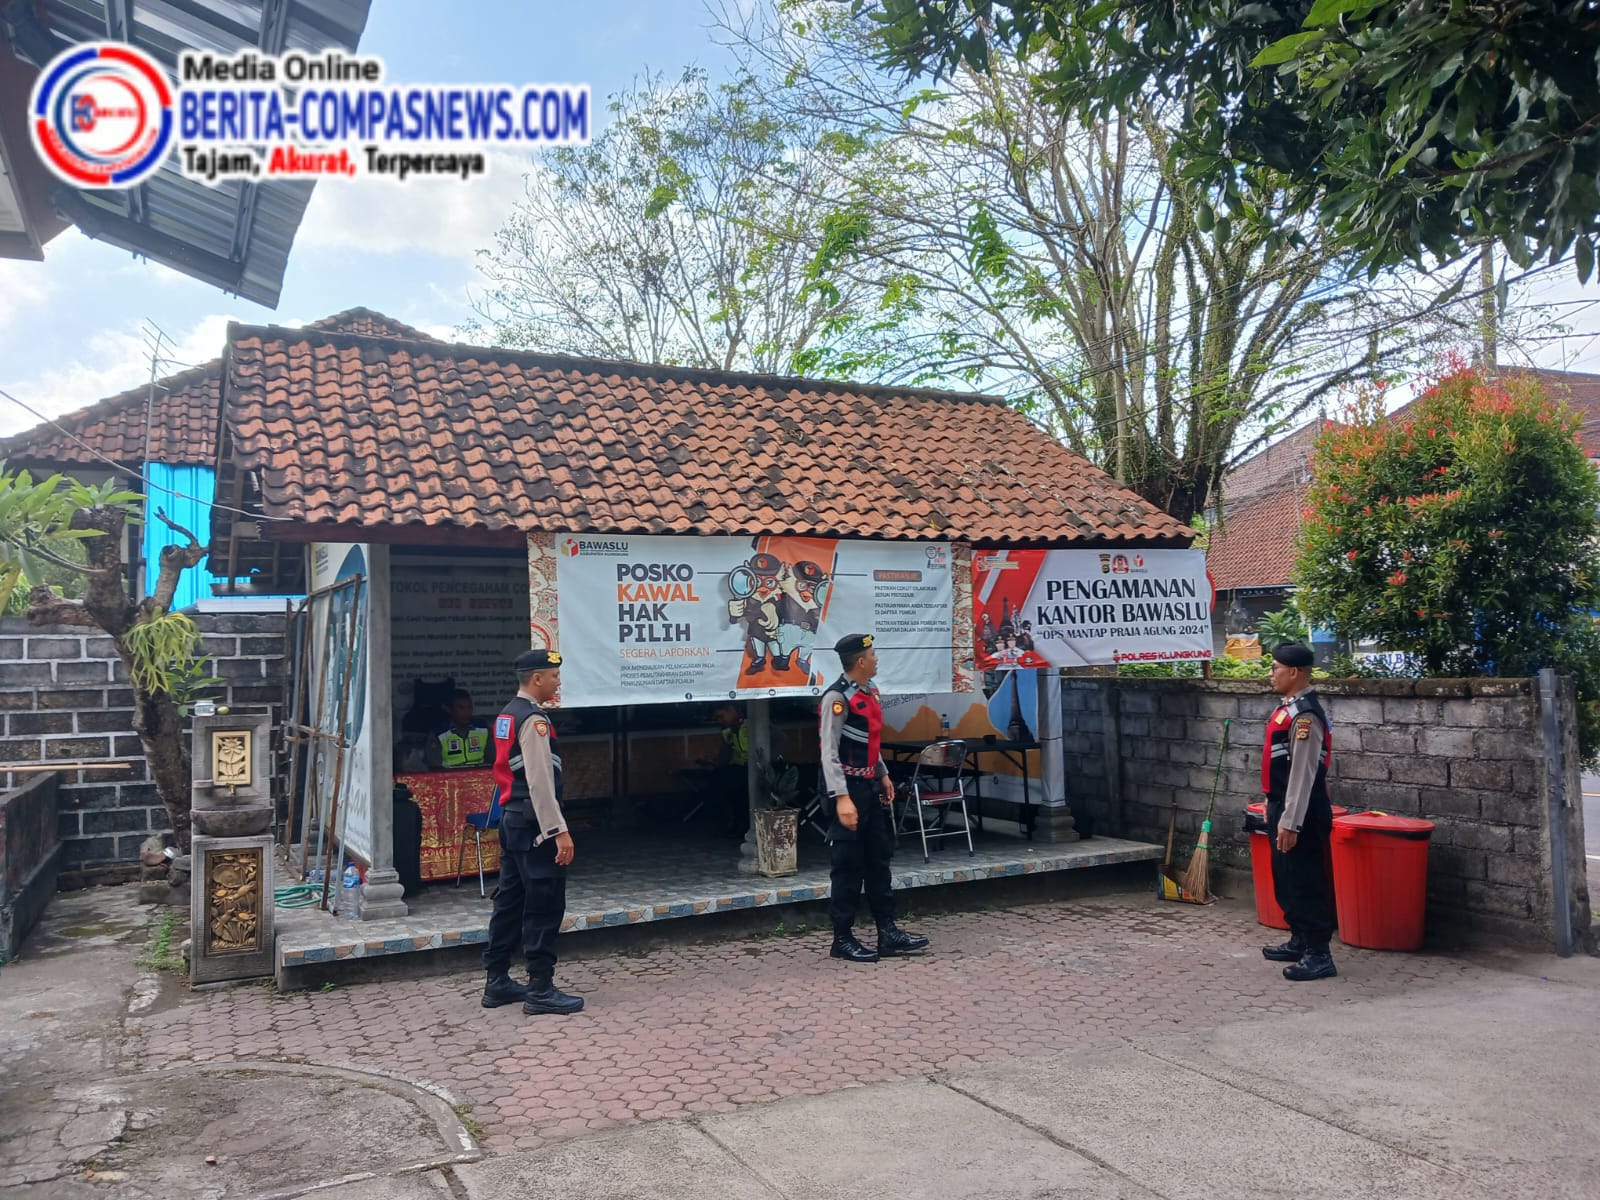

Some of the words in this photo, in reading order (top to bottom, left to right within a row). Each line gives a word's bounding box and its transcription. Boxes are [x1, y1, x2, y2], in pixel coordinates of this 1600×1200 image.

[579, 541, 629, 551] BAWASLU
[616, 563, 694, 582] POSKO
[617, 583, 700, 602] KAWAL
[1046, 578, 1196, 600] PENGAMANAN
[618, 603, 669, 622] HAK
[1037, 603, 1116, 625] KANTOR
[1122, 601, 1208, 623] BAWASLU
[619, 623, 691, 643] PILIH
[1067, 628, 1107, 639] MANTAP
[1110, 627, 1141, 637] PRAJA
[1143, 625, 1176, 636] AGUNG
[620, 648, 657, 658] SEGERA
[658, 647, 710, 657] LAPORKAN
[1121, 651, 1157, 661] POLRES
[1157, 649, 1212, 660] KLUNGKUNG
